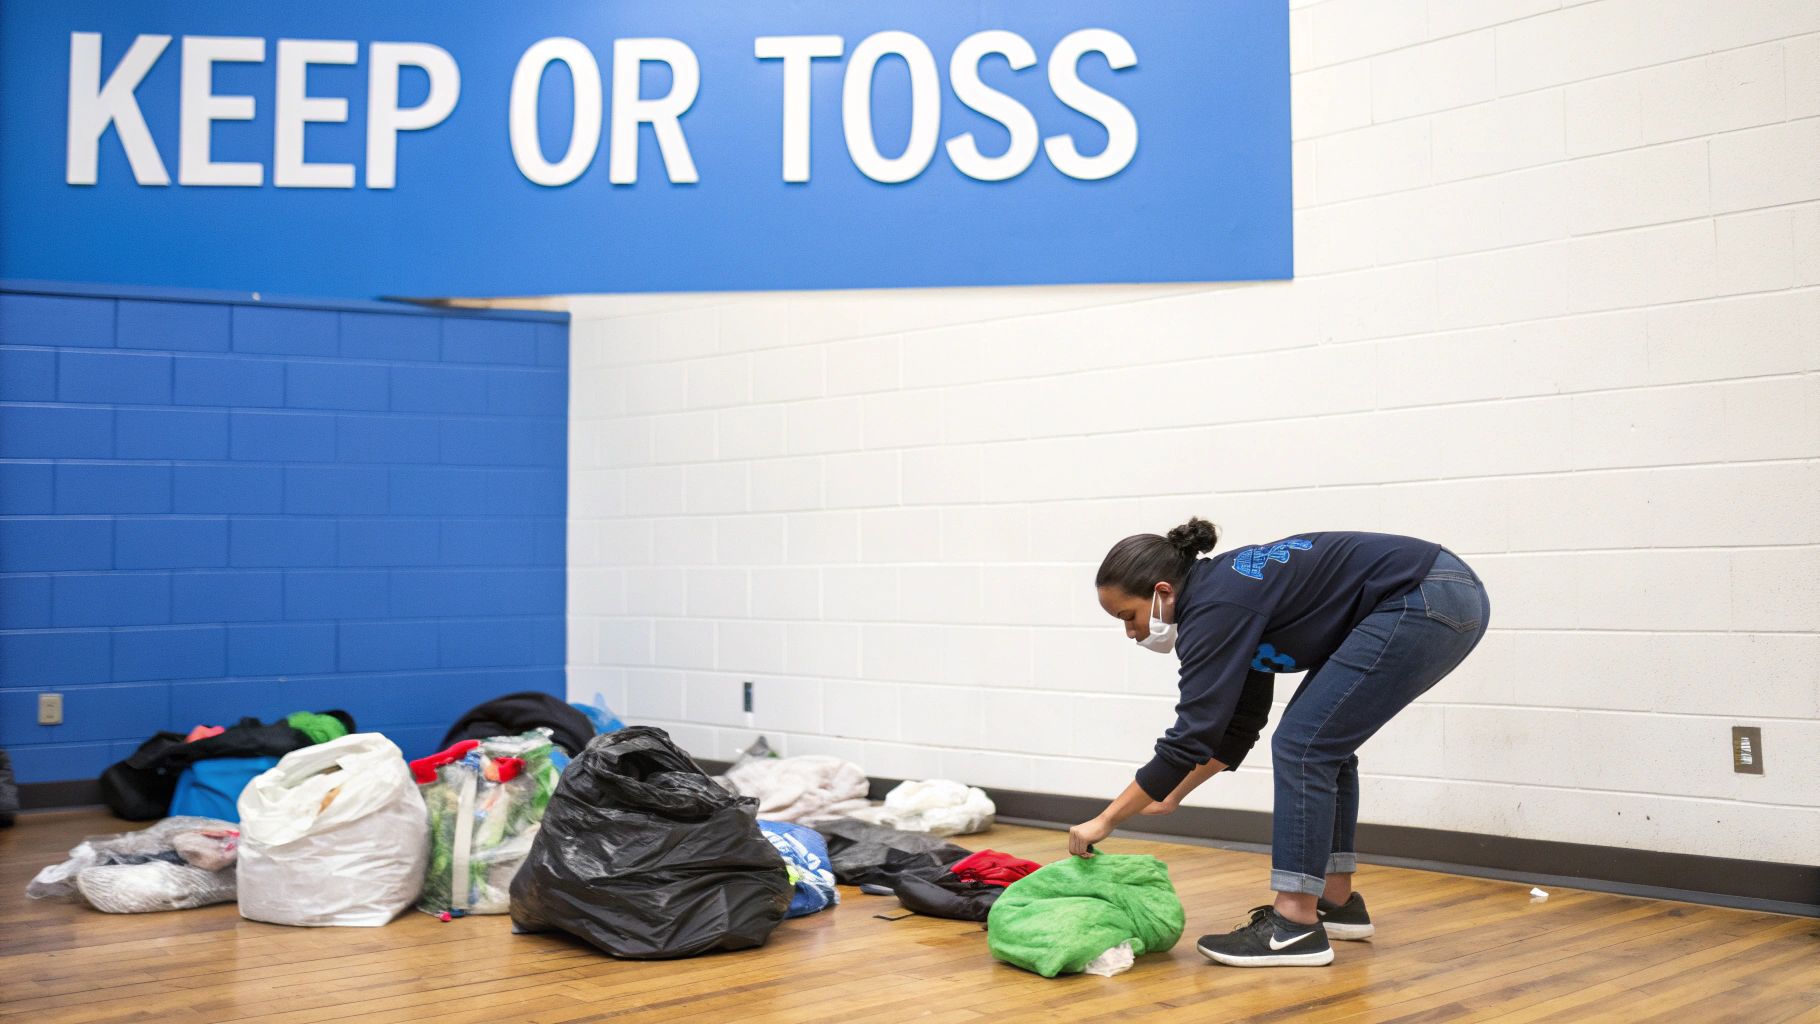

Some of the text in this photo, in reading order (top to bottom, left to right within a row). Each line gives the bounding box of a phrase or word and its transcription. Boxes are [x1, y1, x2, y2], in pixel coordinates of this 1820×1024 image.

[66, 28, 1139, 189] KEEP OR TOSS
